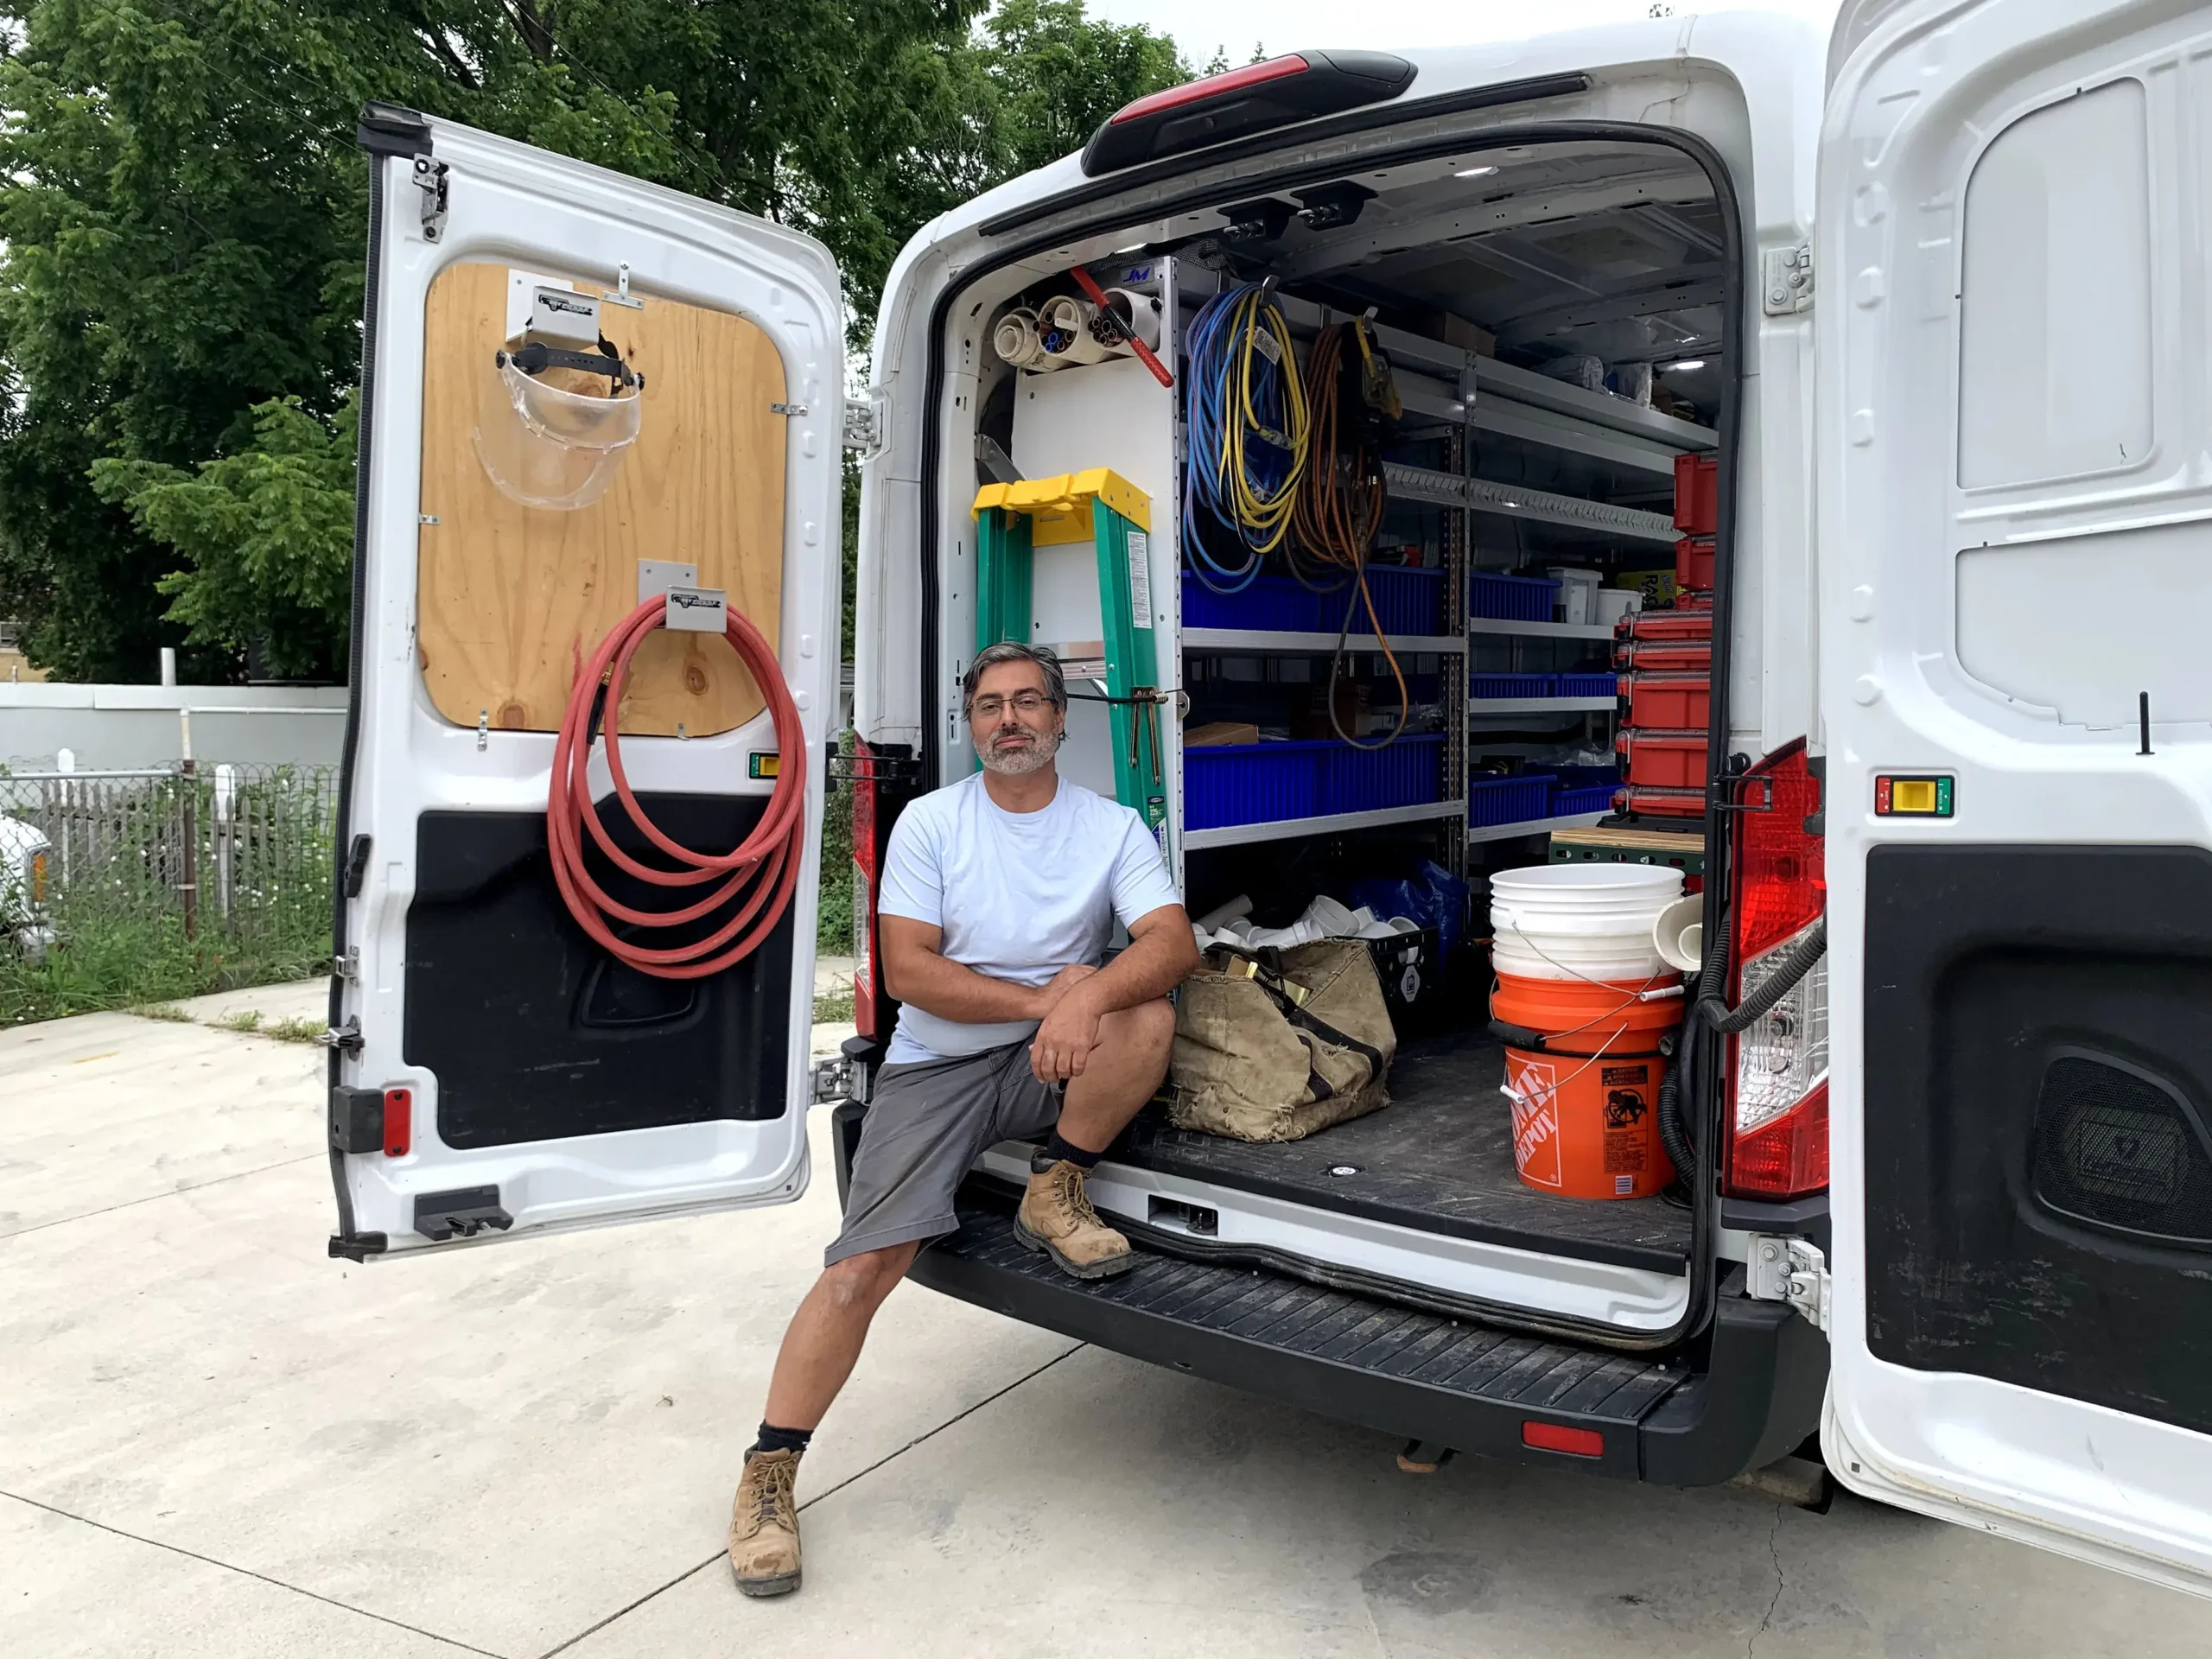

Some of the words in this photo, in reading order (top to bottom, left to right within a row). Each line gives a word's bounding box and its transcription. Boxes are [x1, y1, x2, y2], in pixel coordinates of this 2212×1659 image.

[1123, 267, 1150, 282] JM
[1510, 1063, 1554, 1141] OME
[1516, 1109, 1556, 1172] DEPOT
